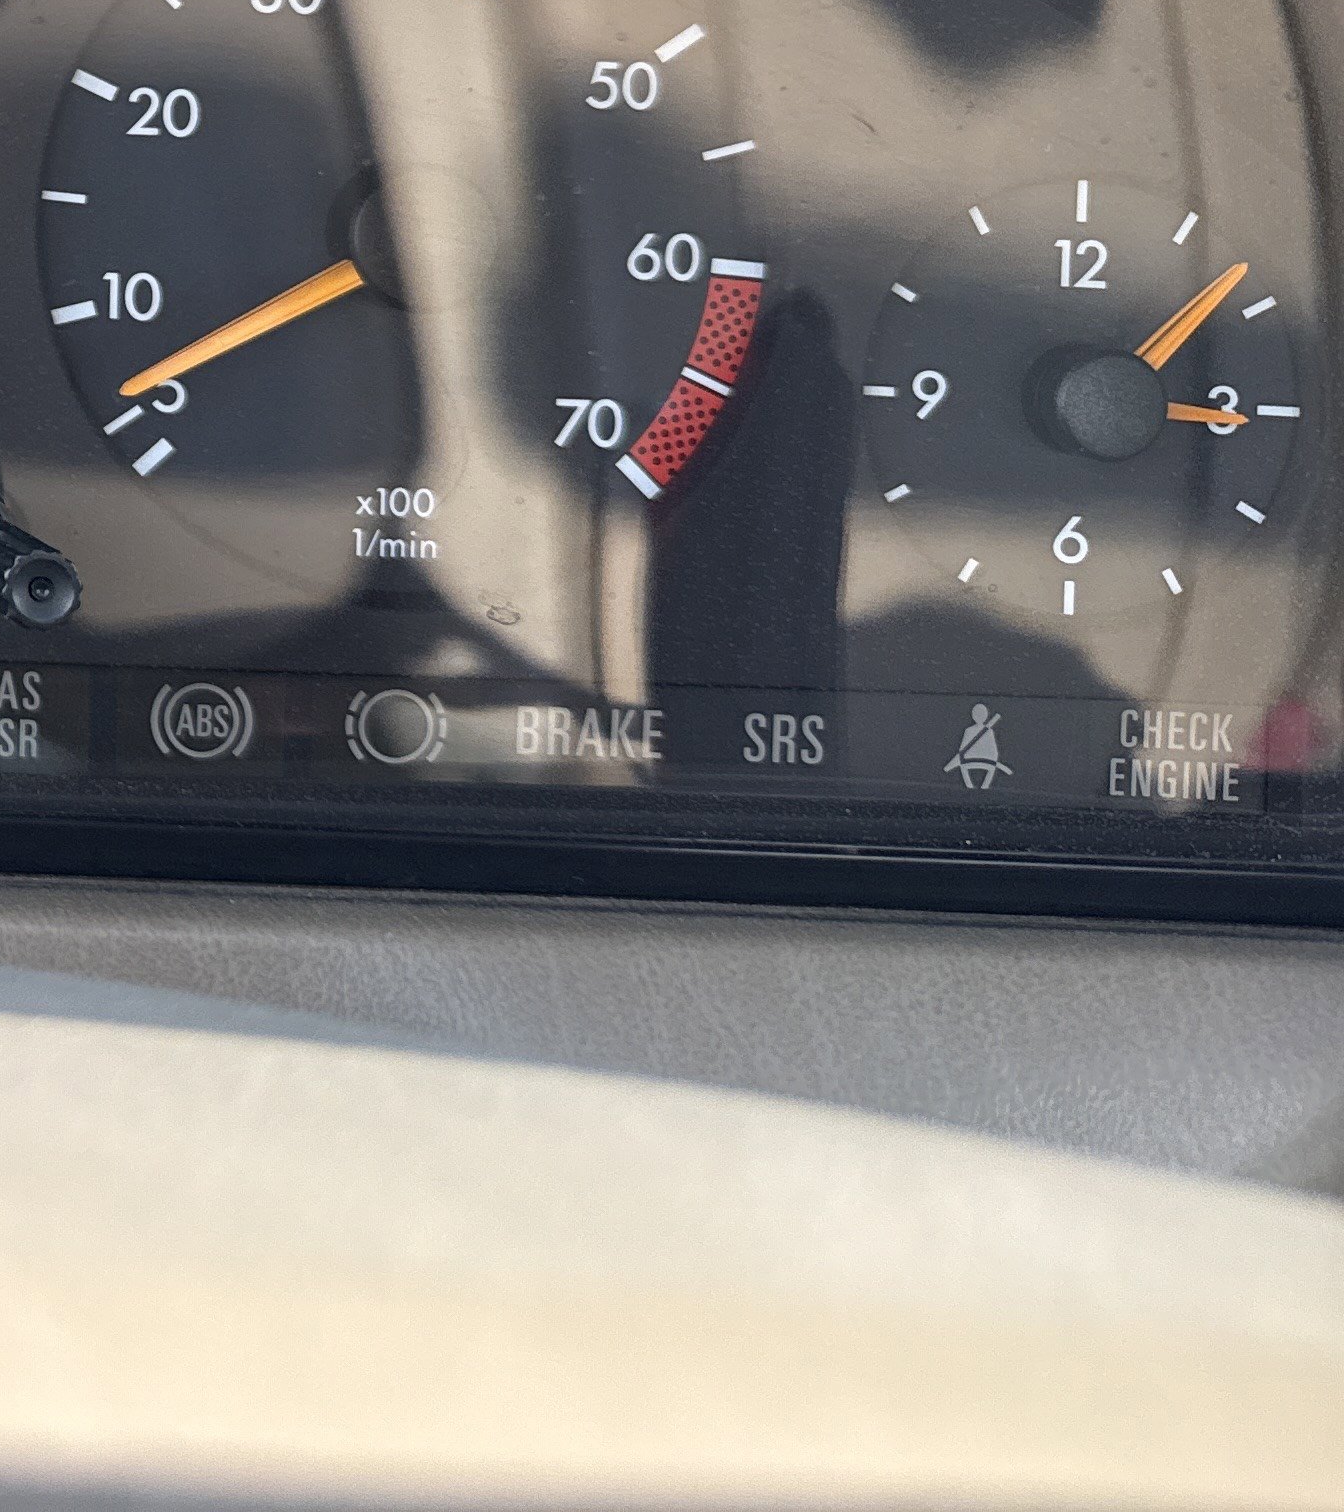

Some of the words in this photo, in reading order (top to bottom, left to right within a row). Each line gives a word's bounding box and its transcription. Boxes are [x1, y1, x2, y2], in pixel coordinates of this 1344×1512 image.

[584, 60, 660, 112] 50
[125, 87, 201, 138] 20
[625, 232, 701, 283] 60
[1053, 238, 1108, 290] 12
[101, 270, 163, 322] 10
[911, 369, 948, 420] 9
[1205, 385, 1240, 436] 3
[554, 396, 625, 450] 70
[354, 487, 436, 519] x100
[351, 527, 438, 561] 1/min
[1052, 515, 1089, 565] 6
[175, 702, 231, 740] ABS
[515, 706, 665, 761] BRAKE
[743, 712, 825, 766] SRS
[1118, 708, 1234, 754] CHECK
[1109, 756, 1241, 804] ENGINE
